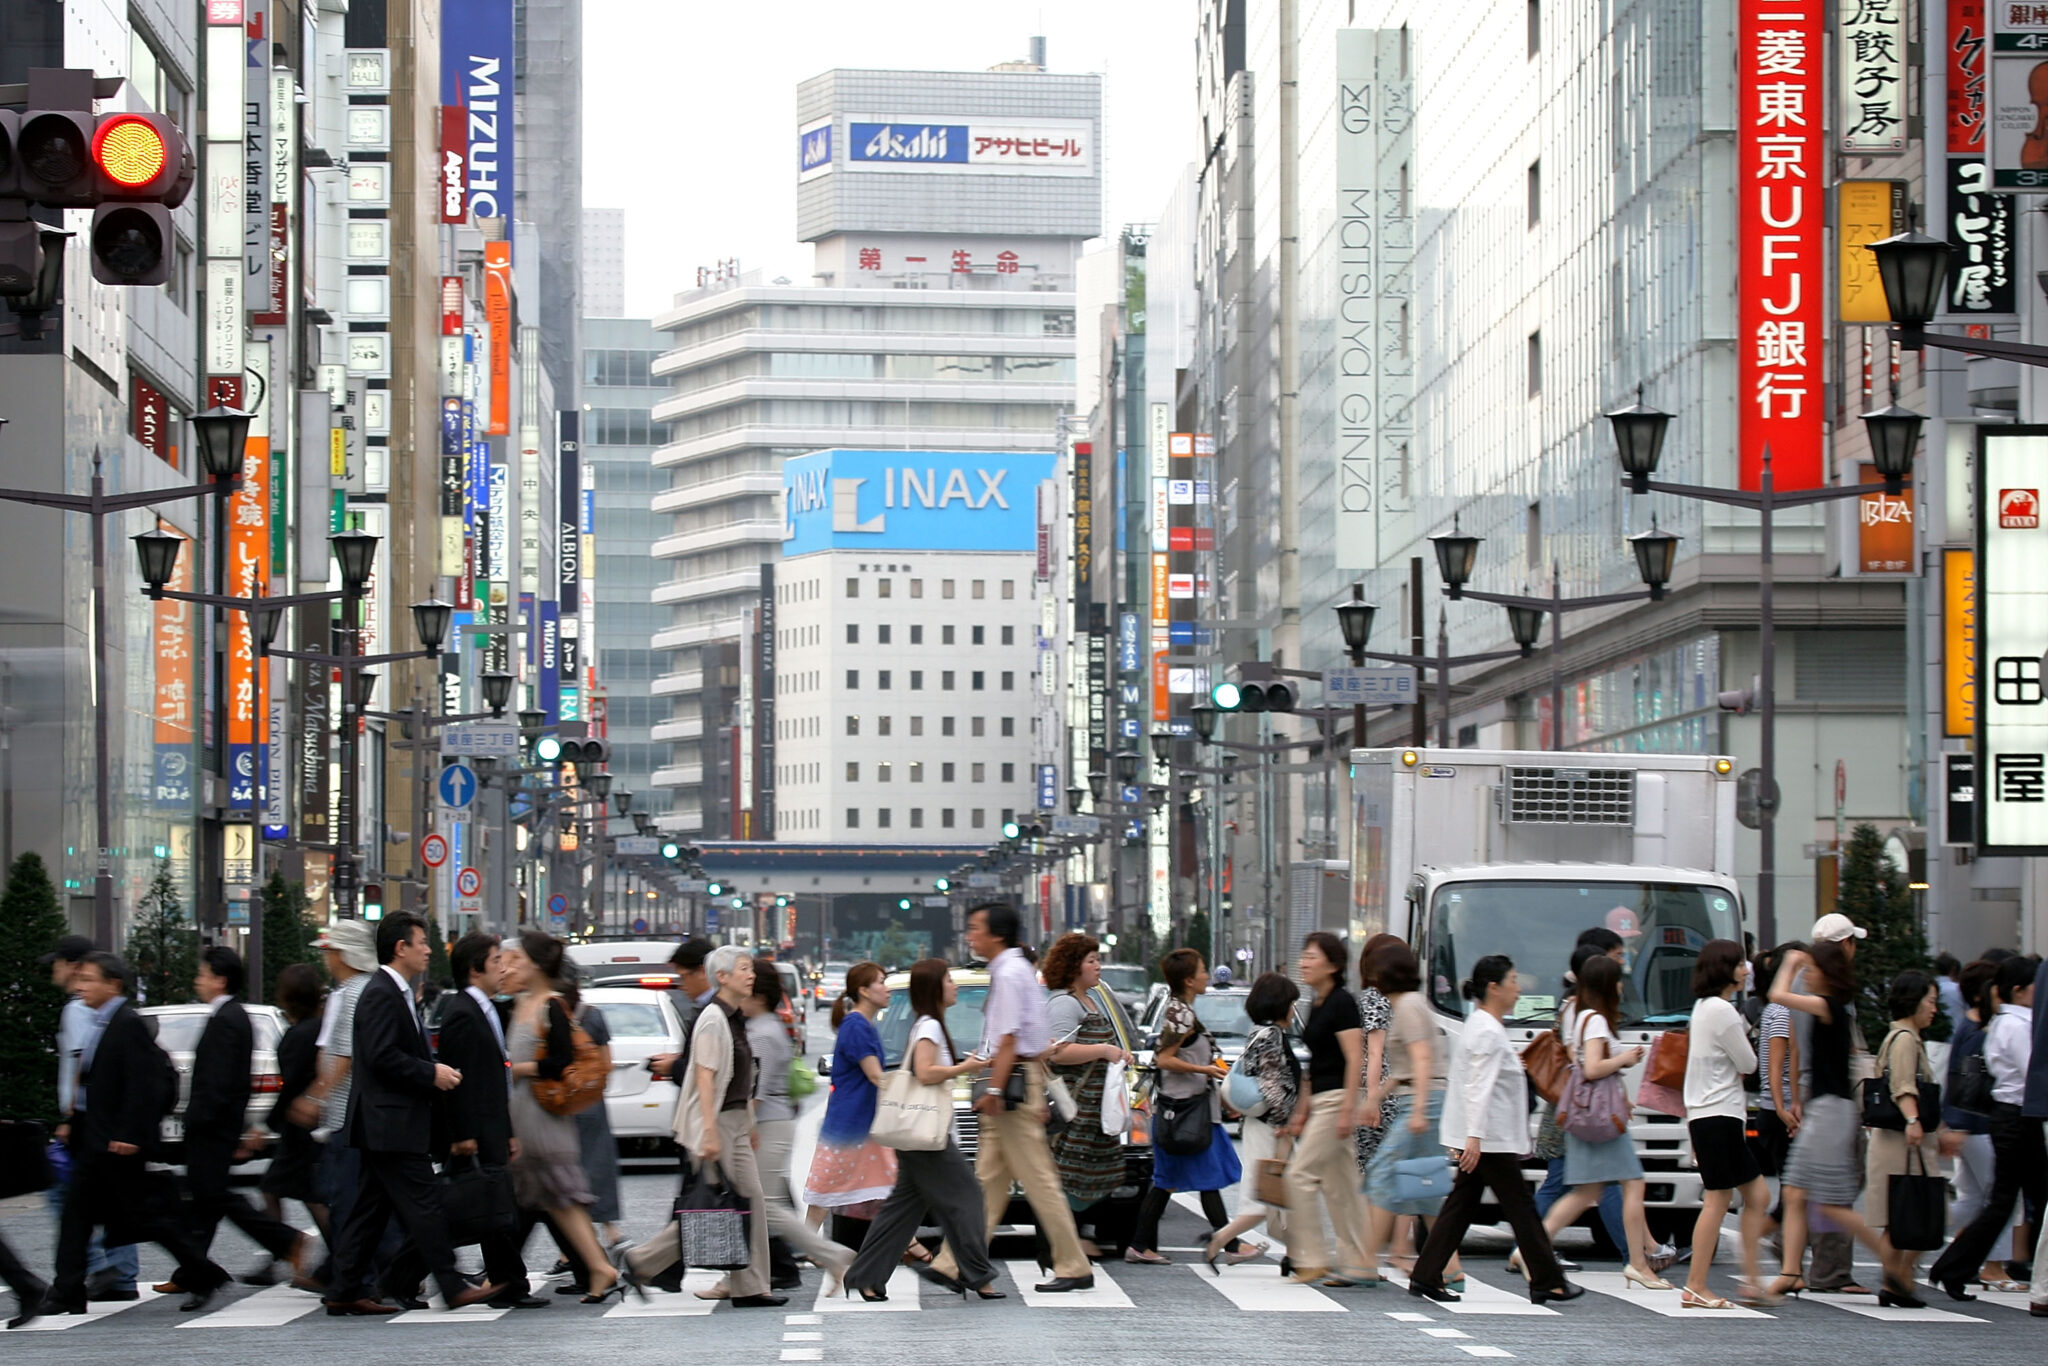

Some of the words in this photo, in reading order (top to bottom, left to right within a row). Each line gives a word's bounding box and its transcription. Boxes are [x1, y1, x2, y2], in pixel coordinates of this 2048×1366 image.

[469, 56, 500, 218] MIZUHO
[865, 125, 948, 160] Asahi
[974, 136, 1081, 157] アサヒビール
[443, 150, 465, 217] Aprica
[859, 247, 1019, 273] 第一生命
[792, 468, 829, 513] INAX
[885, 467, 1010, 510] INAX
[562, 522, 577, 584] ALBION
[544, 620, 556, 669] MIZUHO
[1330, 677, 1410, 691] 銀座三丁目
[271, 707, 281, 760] MOON
